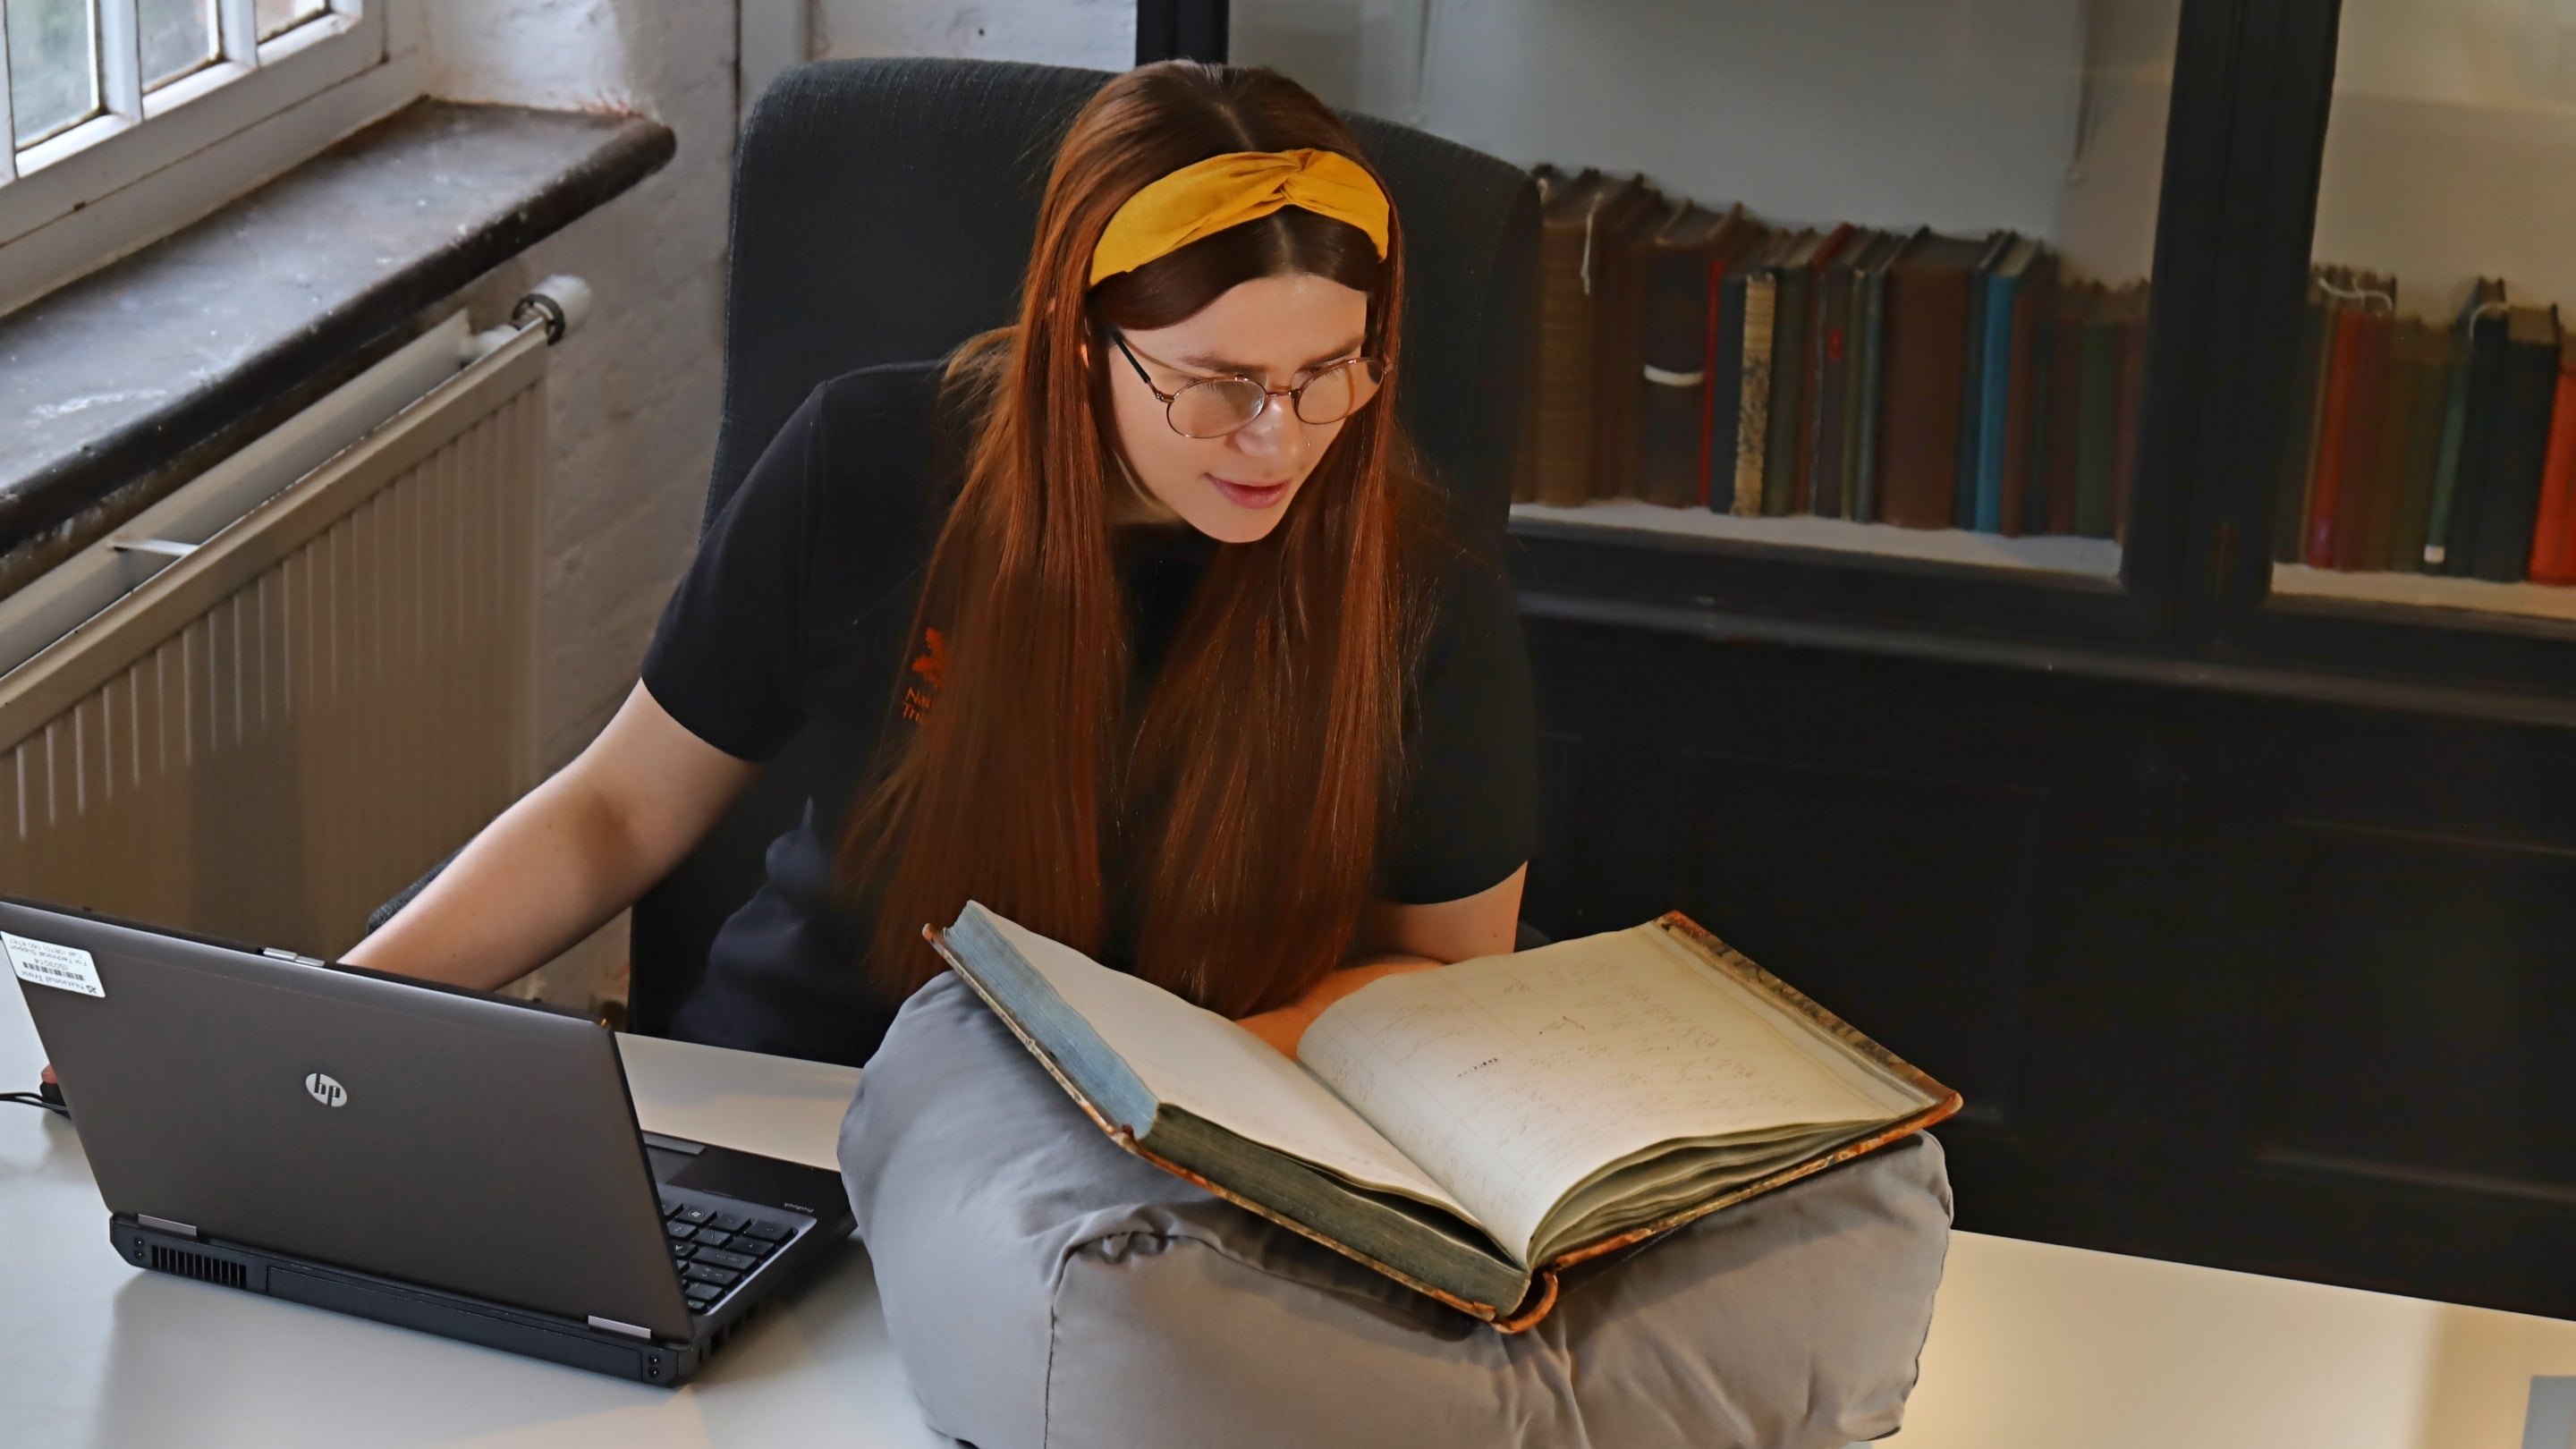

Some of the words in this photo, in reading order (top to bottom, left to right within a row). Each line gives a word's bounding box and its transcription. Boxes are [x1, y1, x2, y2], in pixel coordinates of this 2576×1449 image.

[21, 970, 45, 982] Trust
[46, 976, 85, 990] National
[311, 1072, 344, 1107] hp
